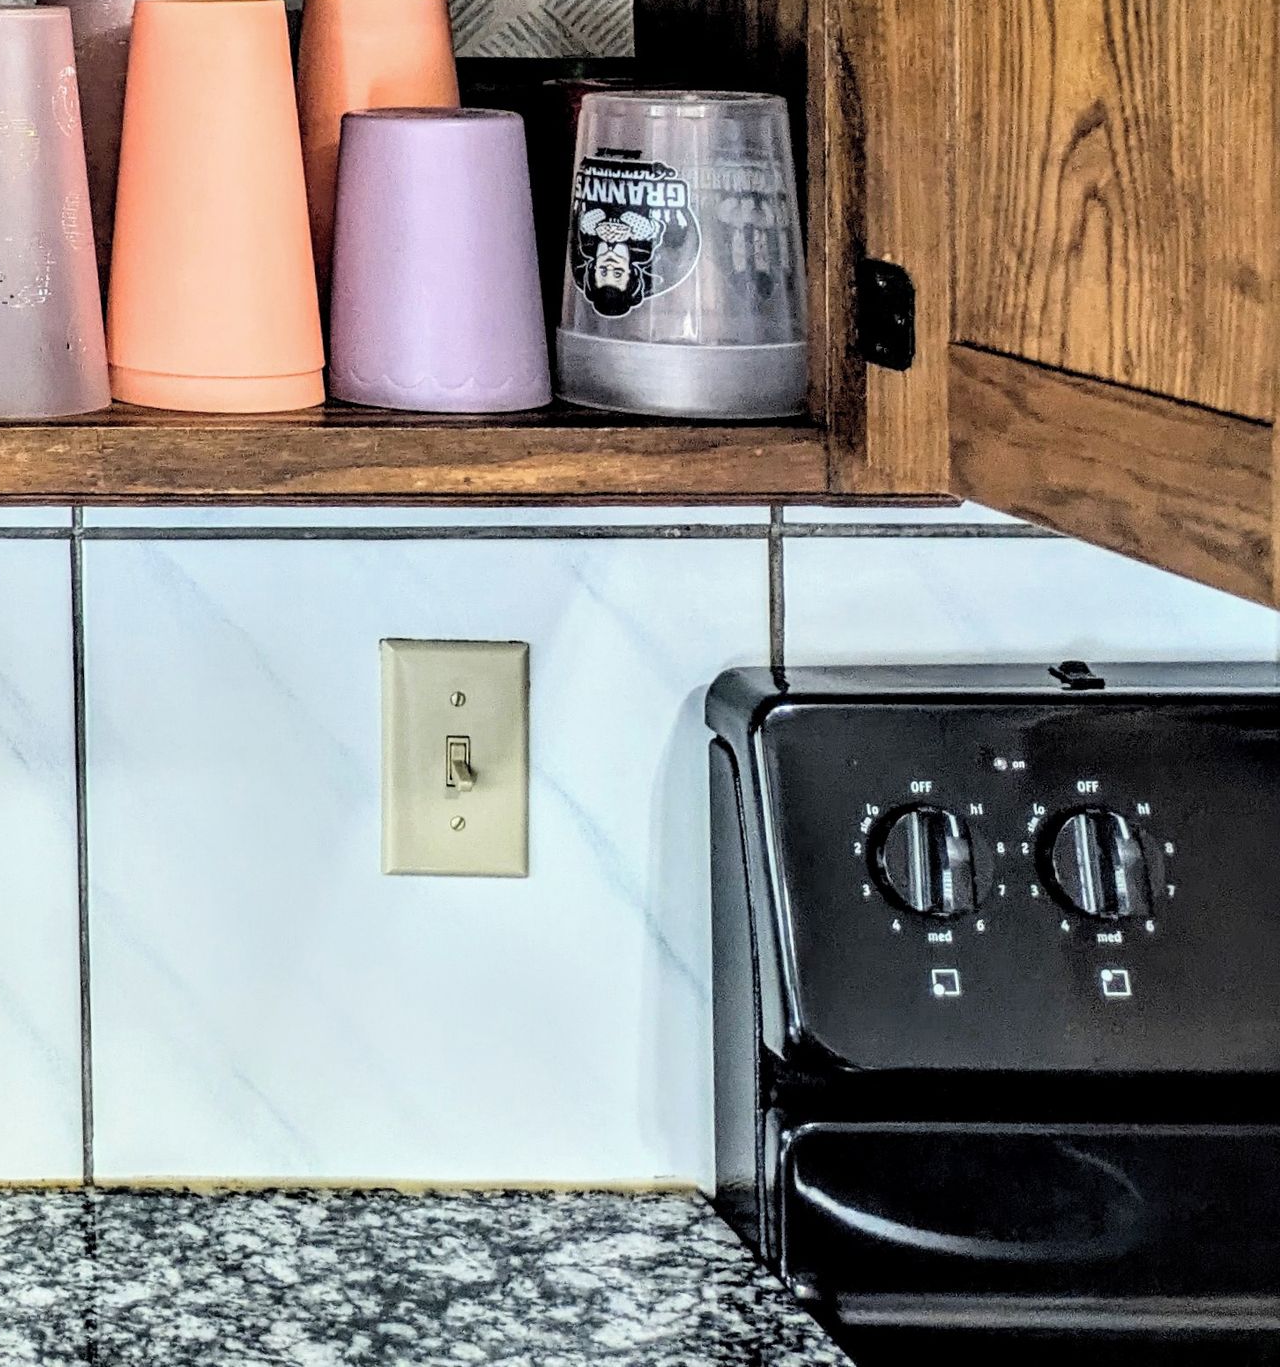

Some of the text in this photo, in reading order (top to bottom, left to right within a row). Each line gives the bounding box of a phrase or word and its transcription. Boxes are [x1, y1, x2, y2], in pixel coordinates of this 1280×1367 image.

[1012, 760, 1025, 770] on
[910, 781, 932, 794] OFF
[1077, 781, 1098, 794] OFF
[866, 803, 879, 816] lo
[970, 803, 983, 816] hi
[1033, 803, 1046, 816] lo
[1137, 803, 1150, 816] hi
[854, 842, 862, 855] 2
[997, 842, 1006, 855] 8
[1021, 842, 1030, 855] 2
[1165, 842, 1174, 855] 8
[862, 884, 871, 897] 3
[998, 884, 1006, 897] 7
[1031, 884, 1040, 897] 3
[1167, 884, 1175, 897] 7
[892, 919, 901, 932] 4
[976, 919, 985, 932] 6
[1061, 920, 1070, 933] 4
[1145, 920, 1154, 933] 6
[928, 930, 953, 944] med
[1097, 931, 1122, 945] med
